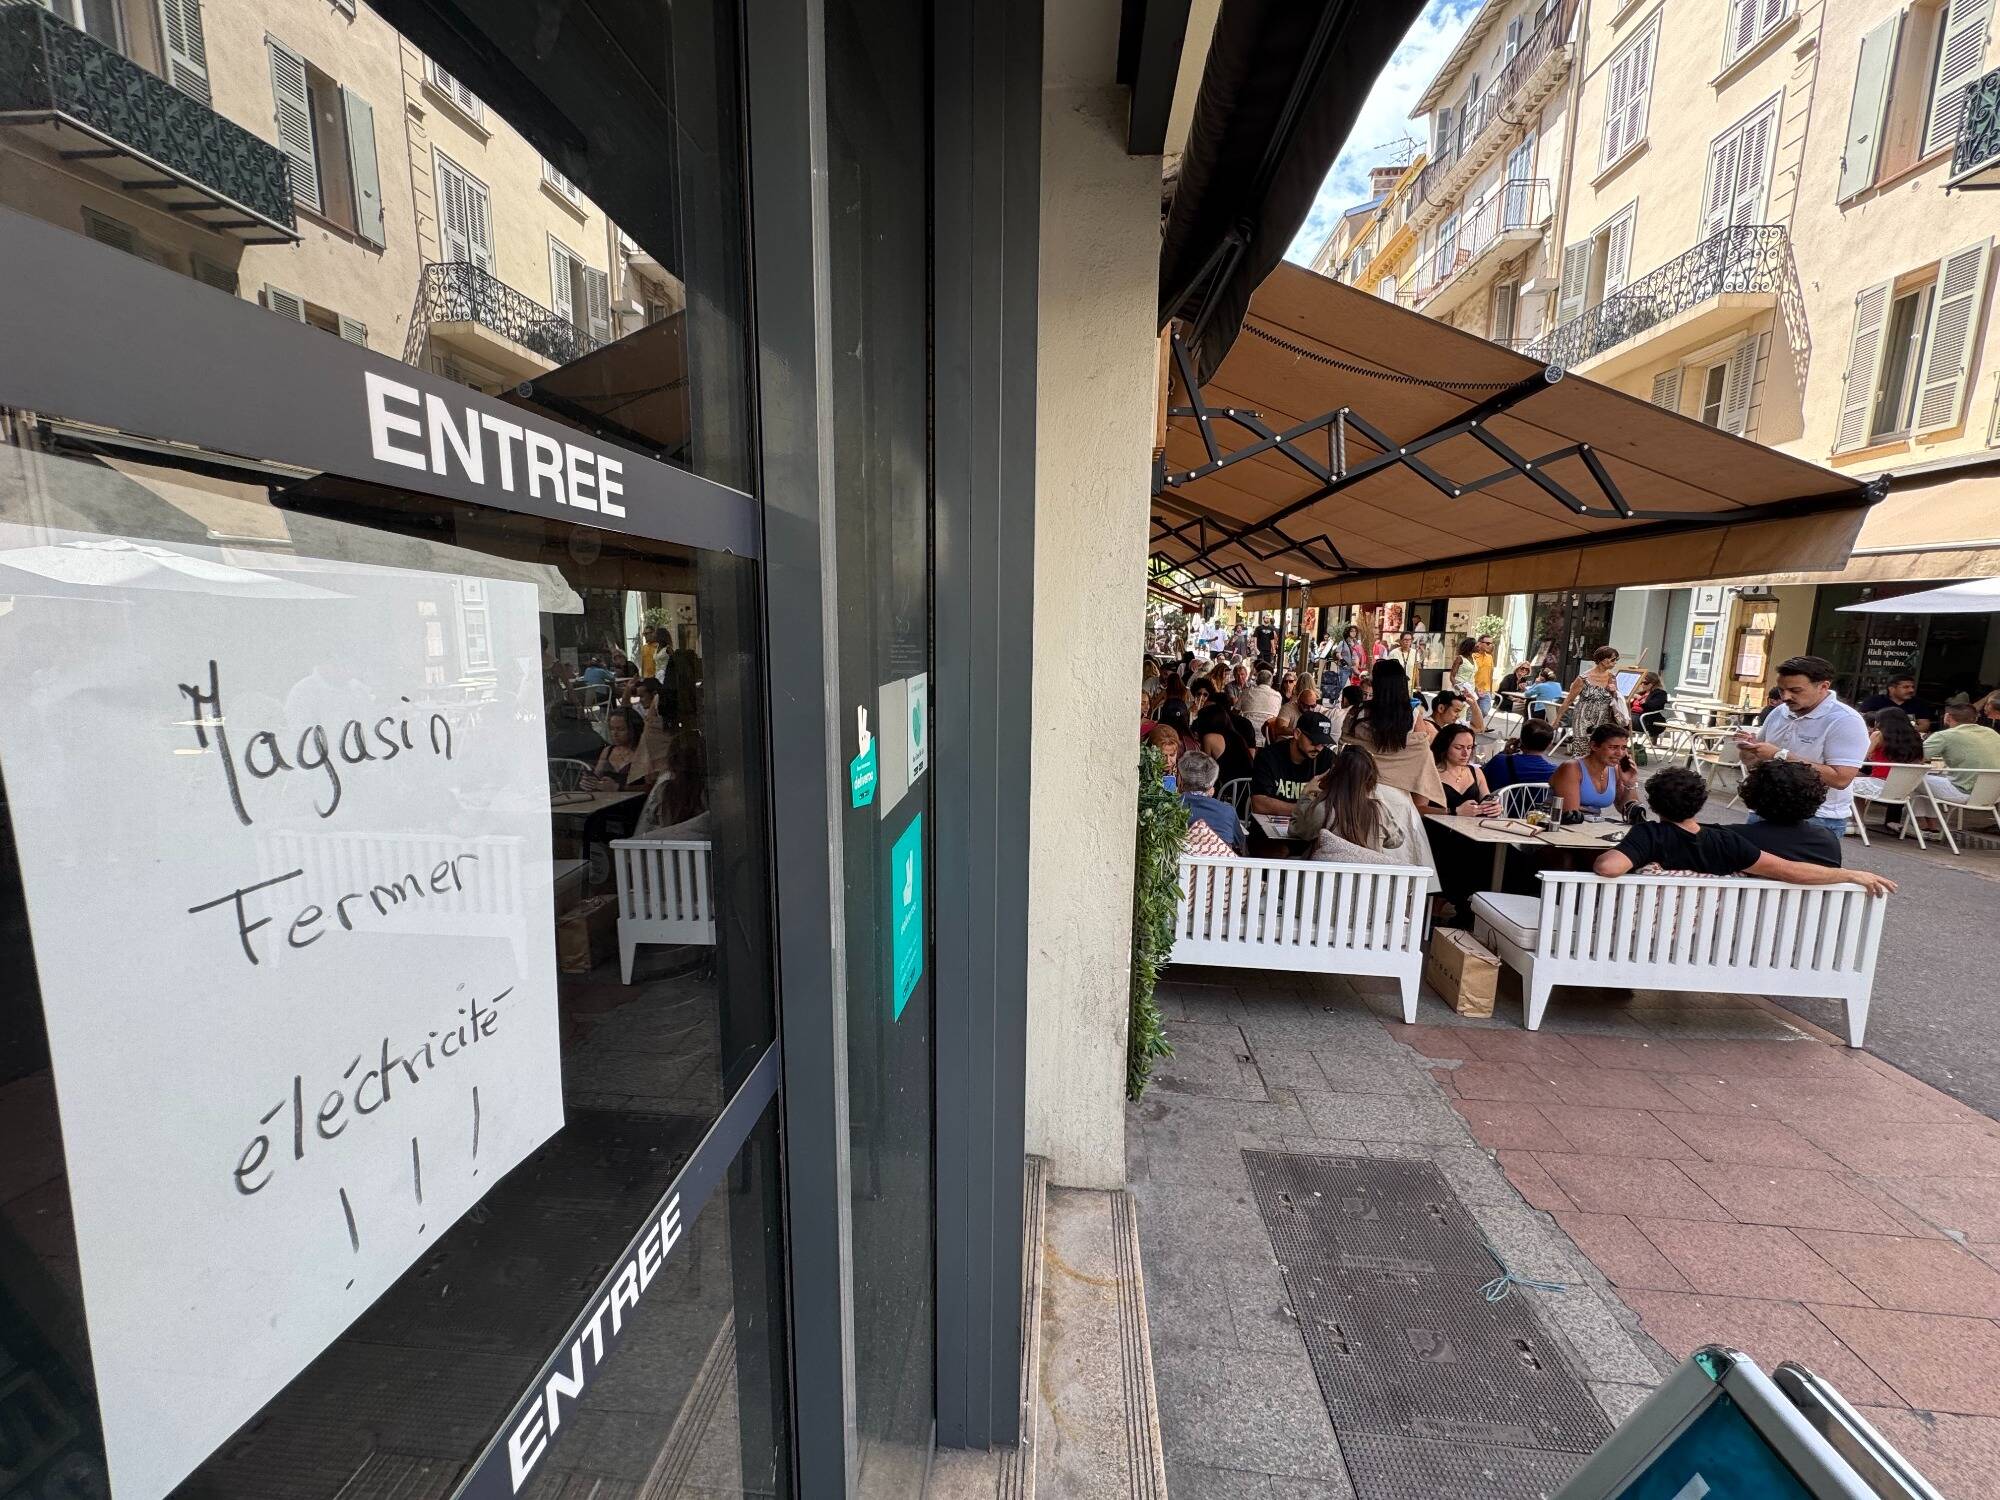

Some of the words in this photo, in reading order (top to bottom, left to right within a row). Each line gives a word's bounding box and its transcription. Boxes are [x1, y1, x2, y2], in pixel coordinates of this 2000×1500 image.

[364, 371, 626, 519] ENTREE
[1869, 638, 1896, 648] Mangia
[177, 659, 453, 827] Magasin
[187, 853, 479, 966] Fermer
[508, 1191, 682, 1495] ENTREE
